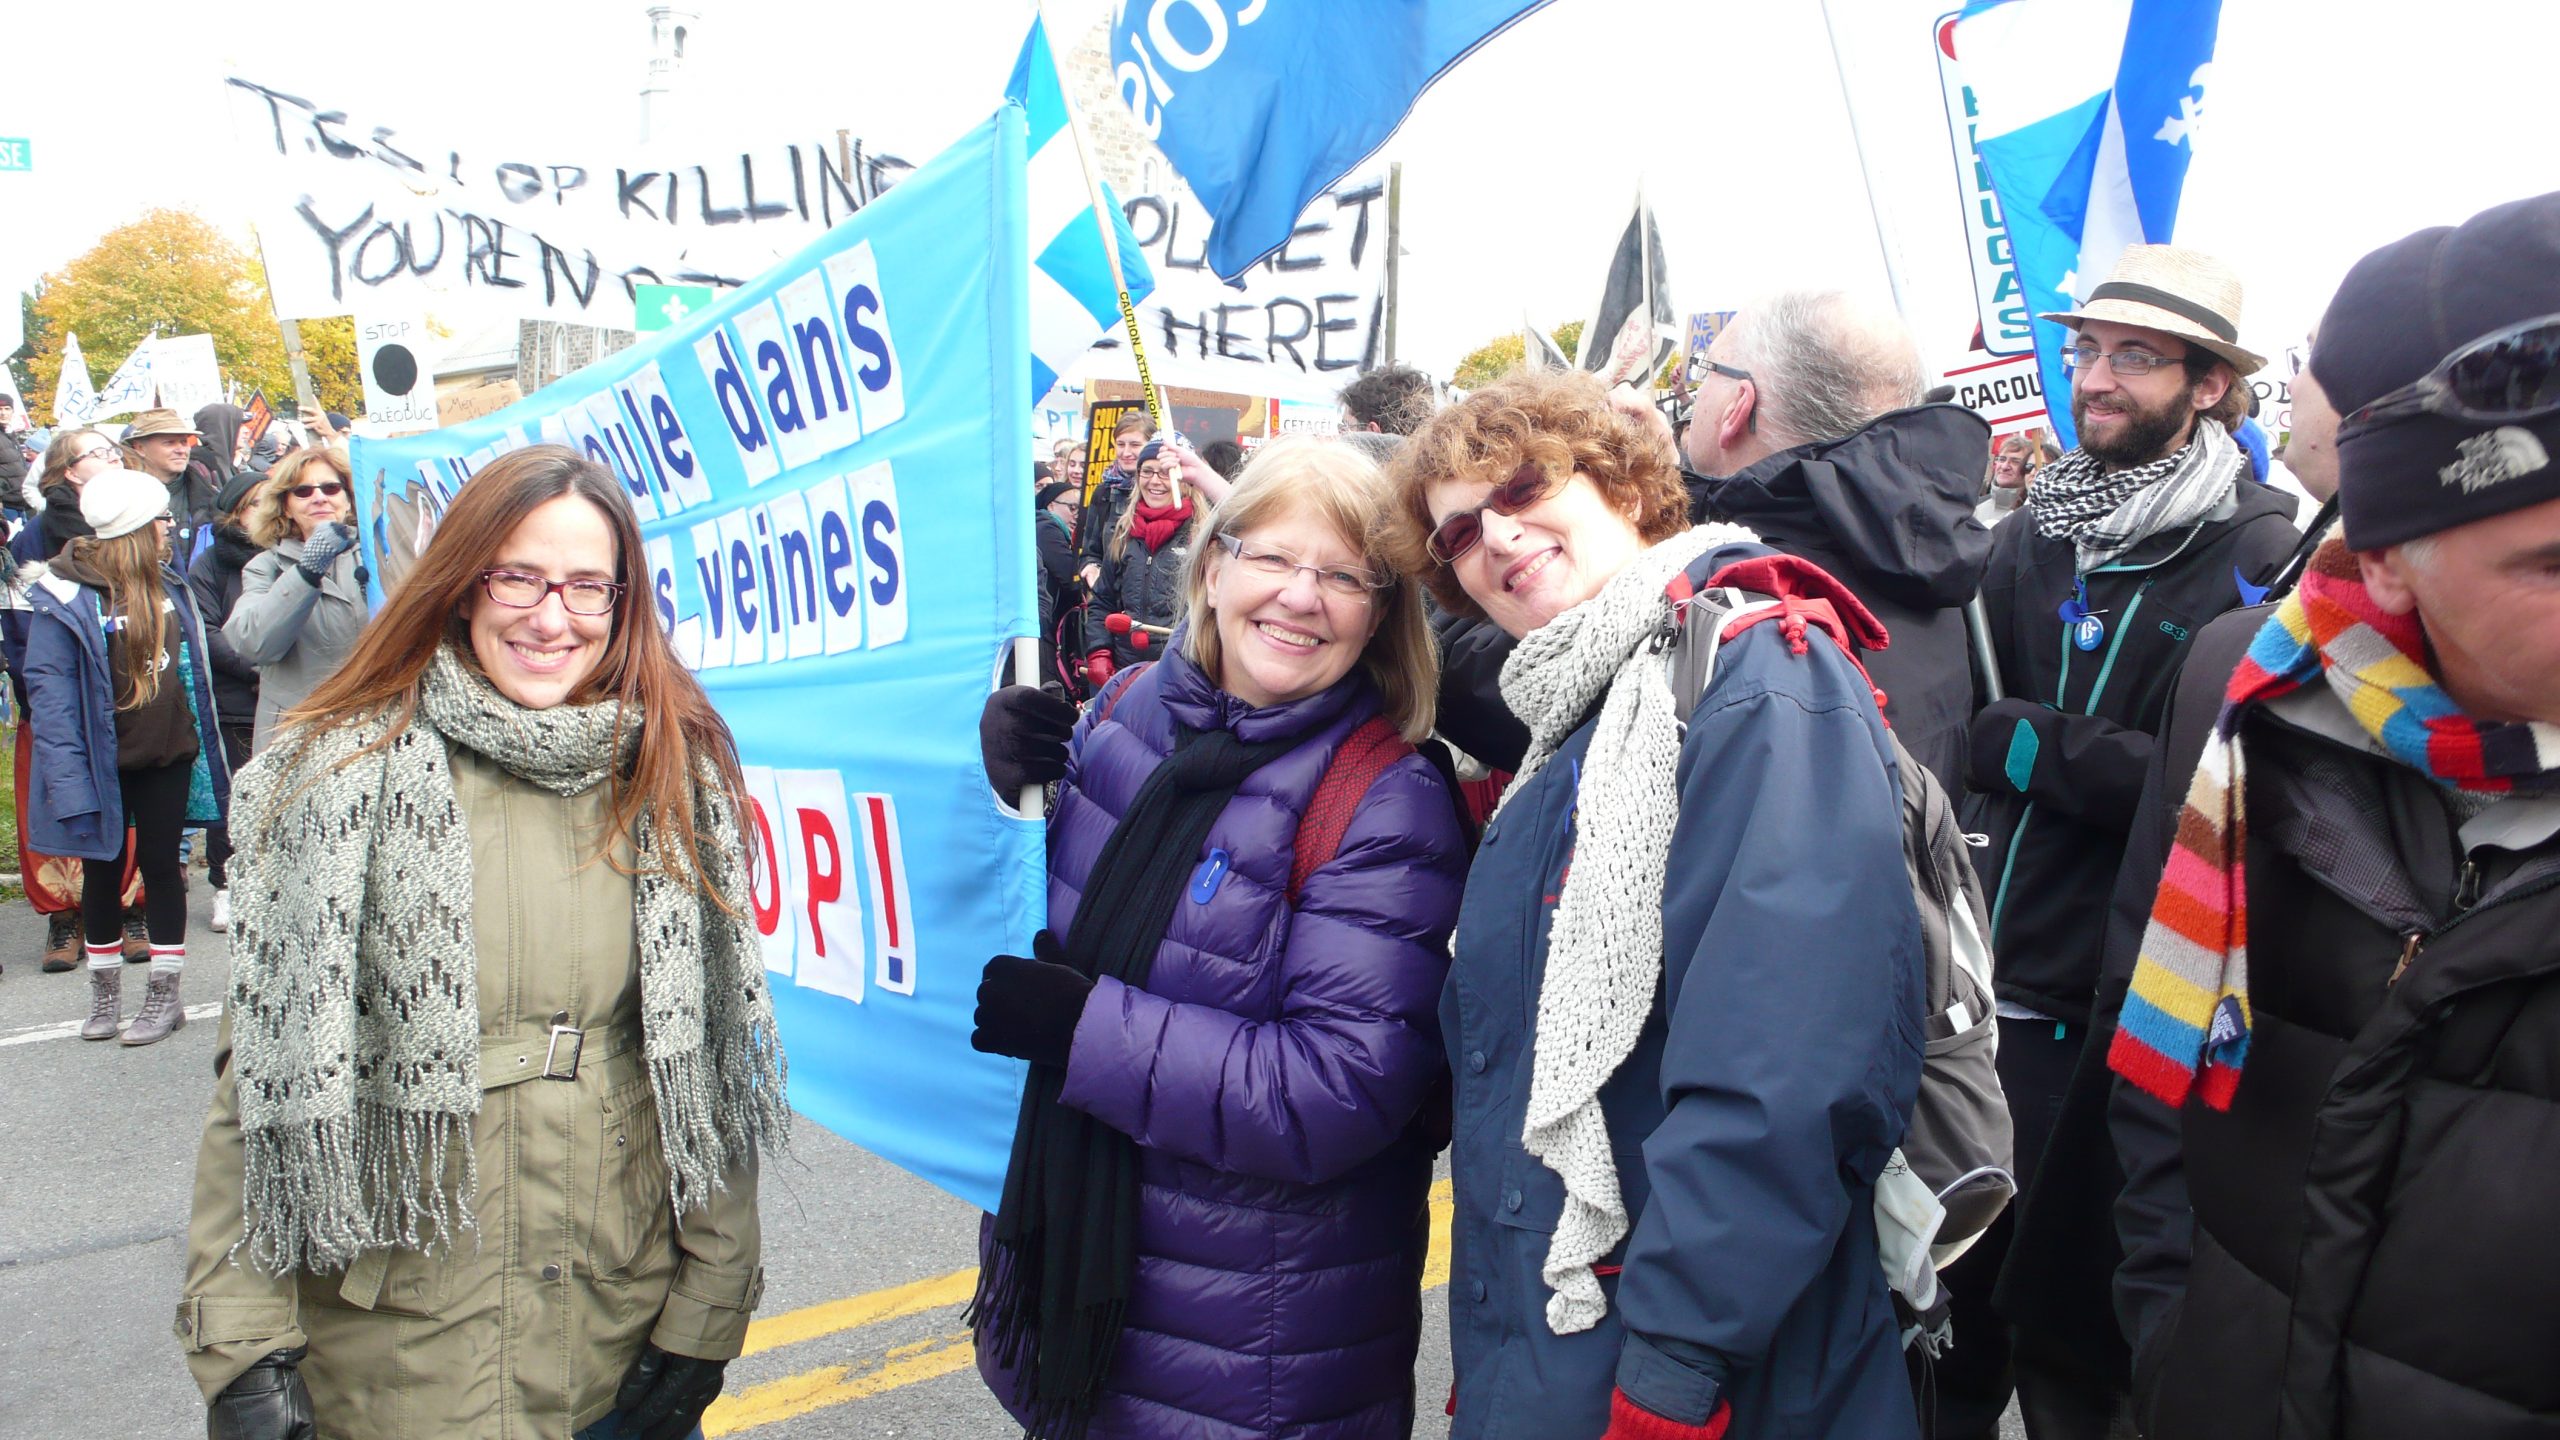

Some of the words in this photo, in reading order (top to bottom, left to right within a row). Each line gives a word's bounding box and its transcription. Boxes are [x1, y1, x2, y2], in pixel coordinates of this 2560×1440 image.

[1124, 176, 1383, 274] PLET
[365, 321, 411, 340] STOP
[714, 283, 893, 453] dans
[1119, 291, 1141, 347] CAUTION
[1134, 353, 1159, 420] ATTENTION
[369, 405, 434, 424] OLÉODUC
[696, 499, 900, 641] veines
